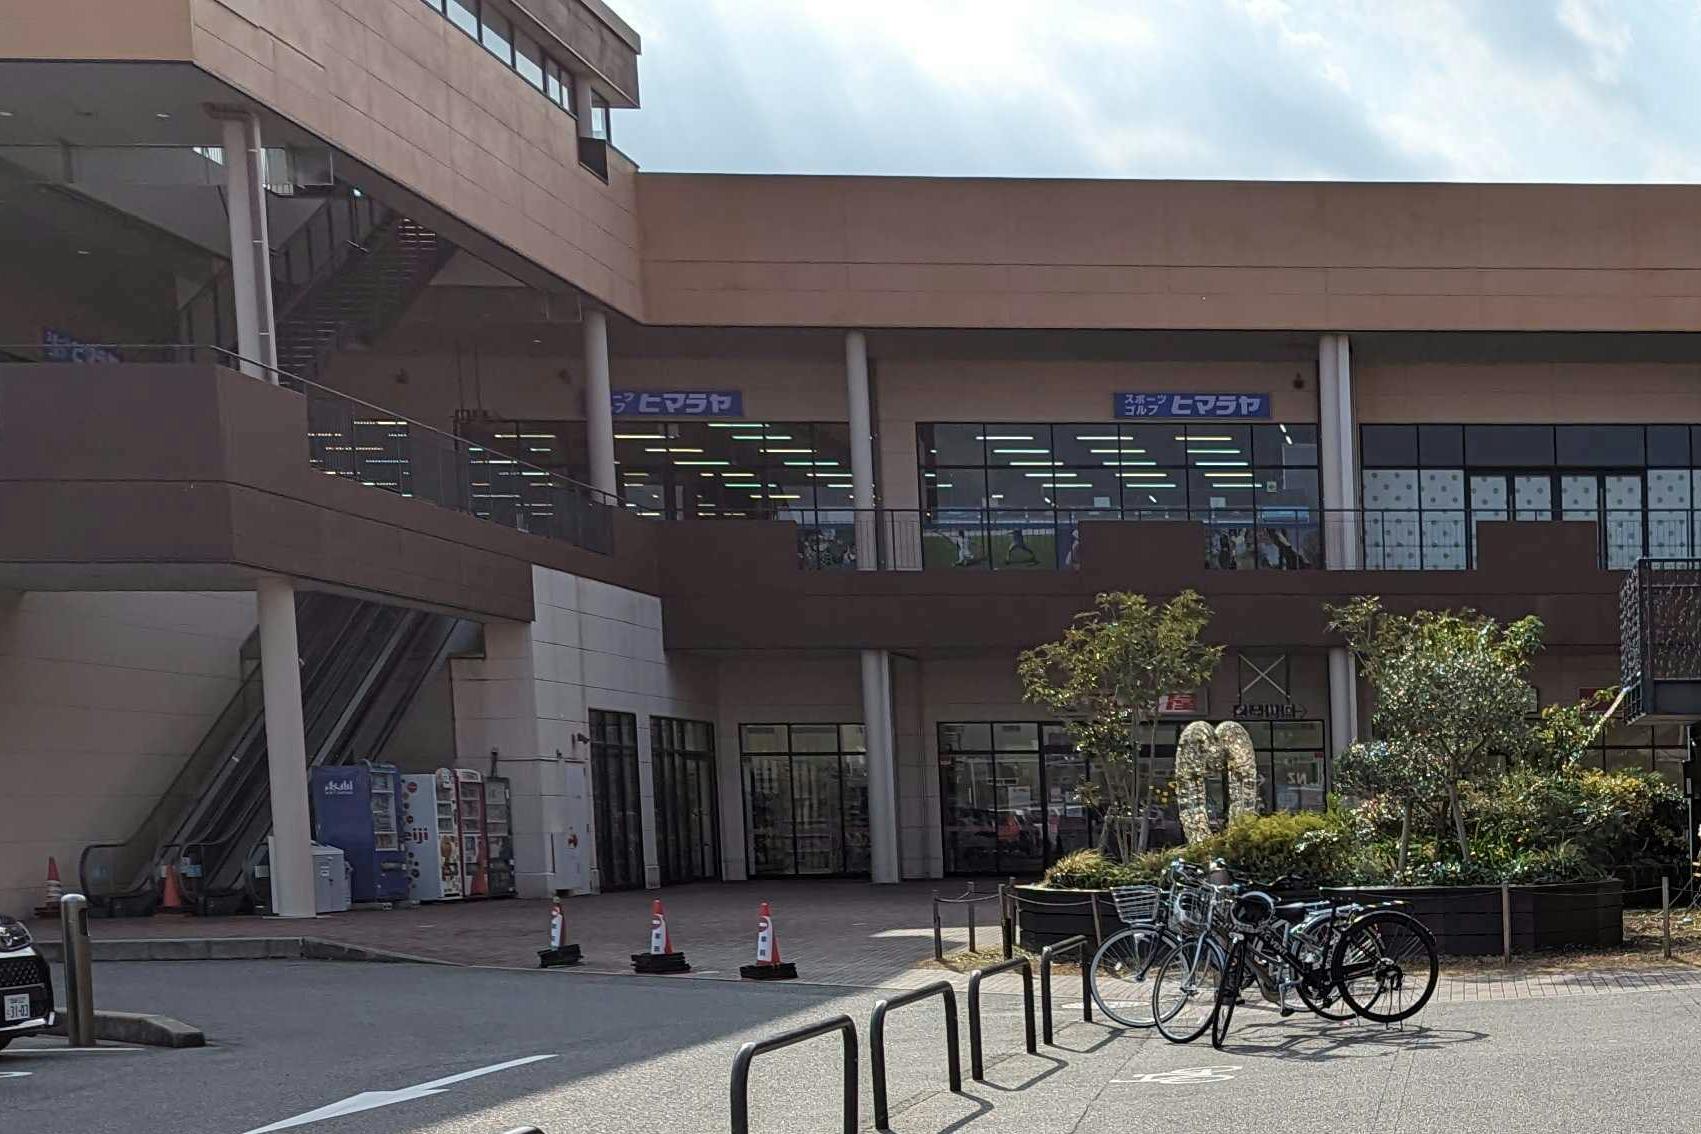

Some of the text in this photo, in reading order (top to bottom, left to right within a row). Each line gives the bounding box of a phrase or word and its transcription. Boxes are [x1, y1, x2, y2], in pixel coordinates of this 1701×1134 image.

[638, 393, 732, 413] ヒマラヤ
[1124, 394, 1167, 404] スポーツ
[1170, 395, 1261, 415] ヒマラヤ
[1124, 405, 1159, 416] ゴルフ
[399, 828, 428, 844] eiji
